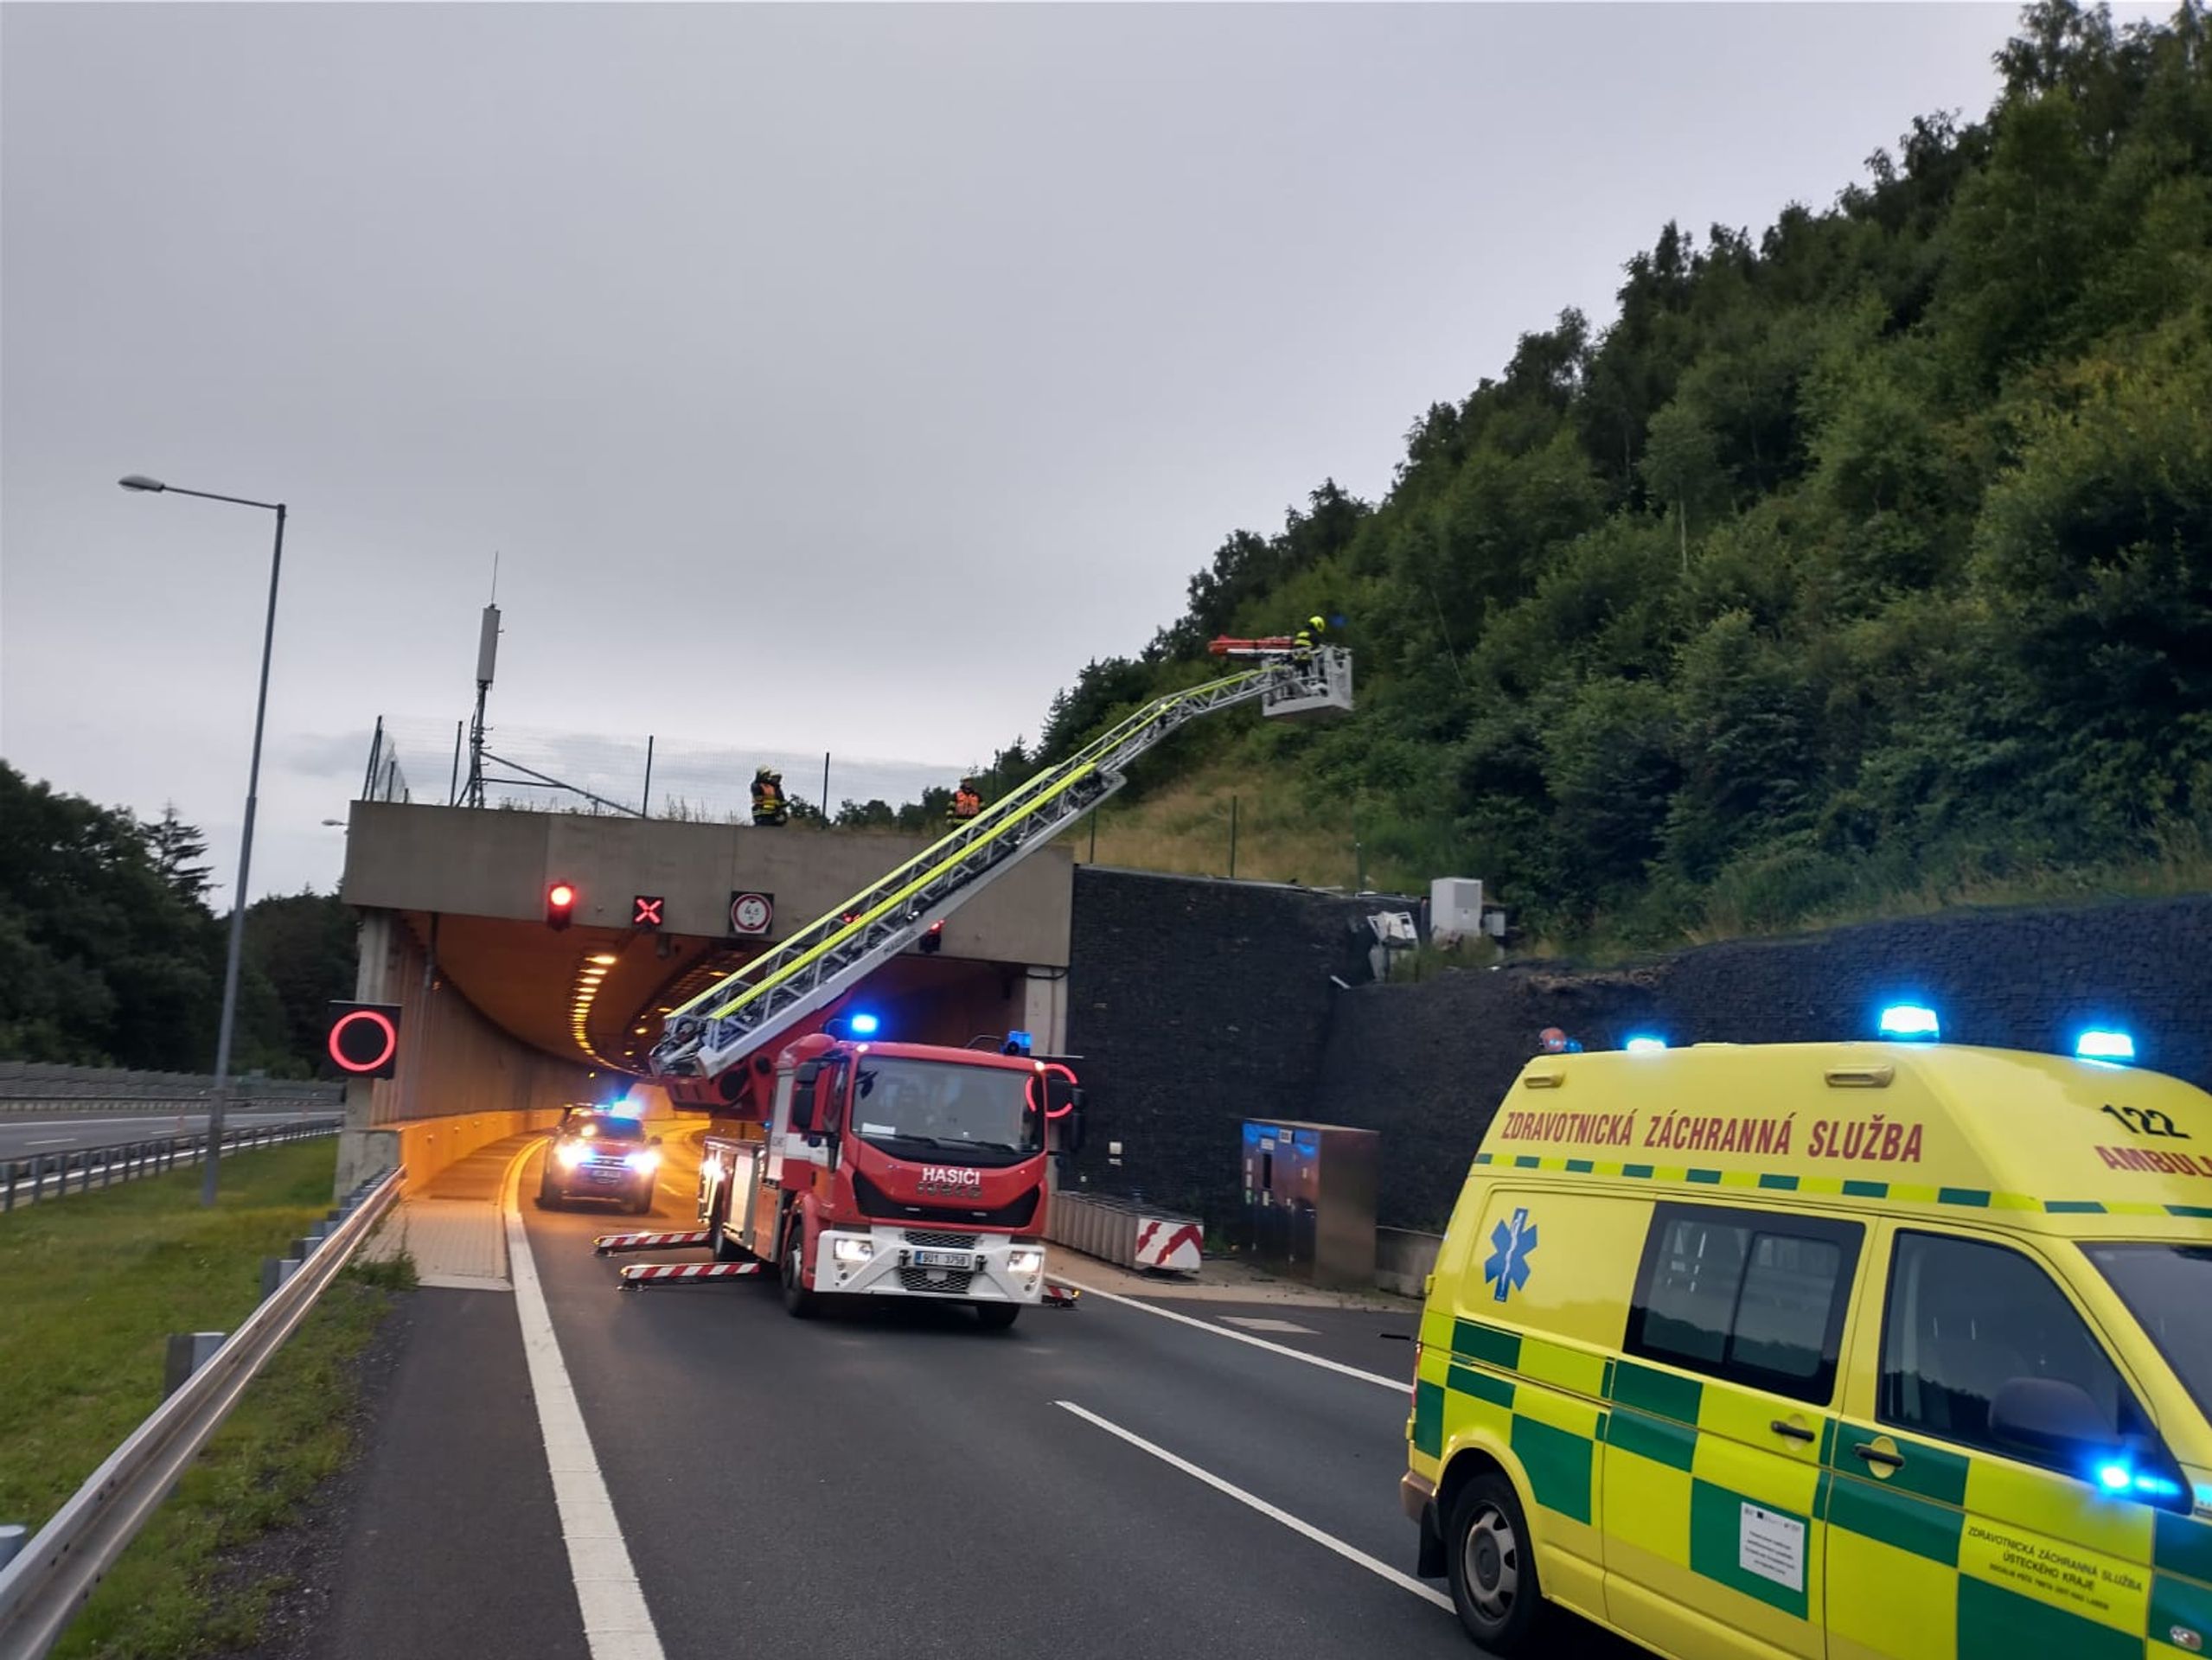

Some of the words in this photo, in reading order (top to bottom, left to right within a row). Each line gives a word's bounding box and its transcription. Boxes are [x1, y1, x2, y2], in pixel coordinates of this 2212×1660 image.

[1501, 1108, 1639, 1146] ZDRAVOTNICKÁ
[1644, 1110, 1797, 1155] ZÁCHRANNÁ
[1808, 1114, 1924, 1163] SLUŽBA
[2100, 1103, 2192, 1140] 122
[922, 1167, 981, 1185] HASIČI
[1967, 1525, 2036, 1557] ZDRAVOTNICKÁ
[2037, 1548, 2100, 1576] ZÁCHRANNÁ
[2101, 1569, 2143, 1593] SLUŽBA
[2003, 1551, 2061, 1580] ÚSTECKÉHO
[2062, 1571, 2095, 1592] KRAJE
